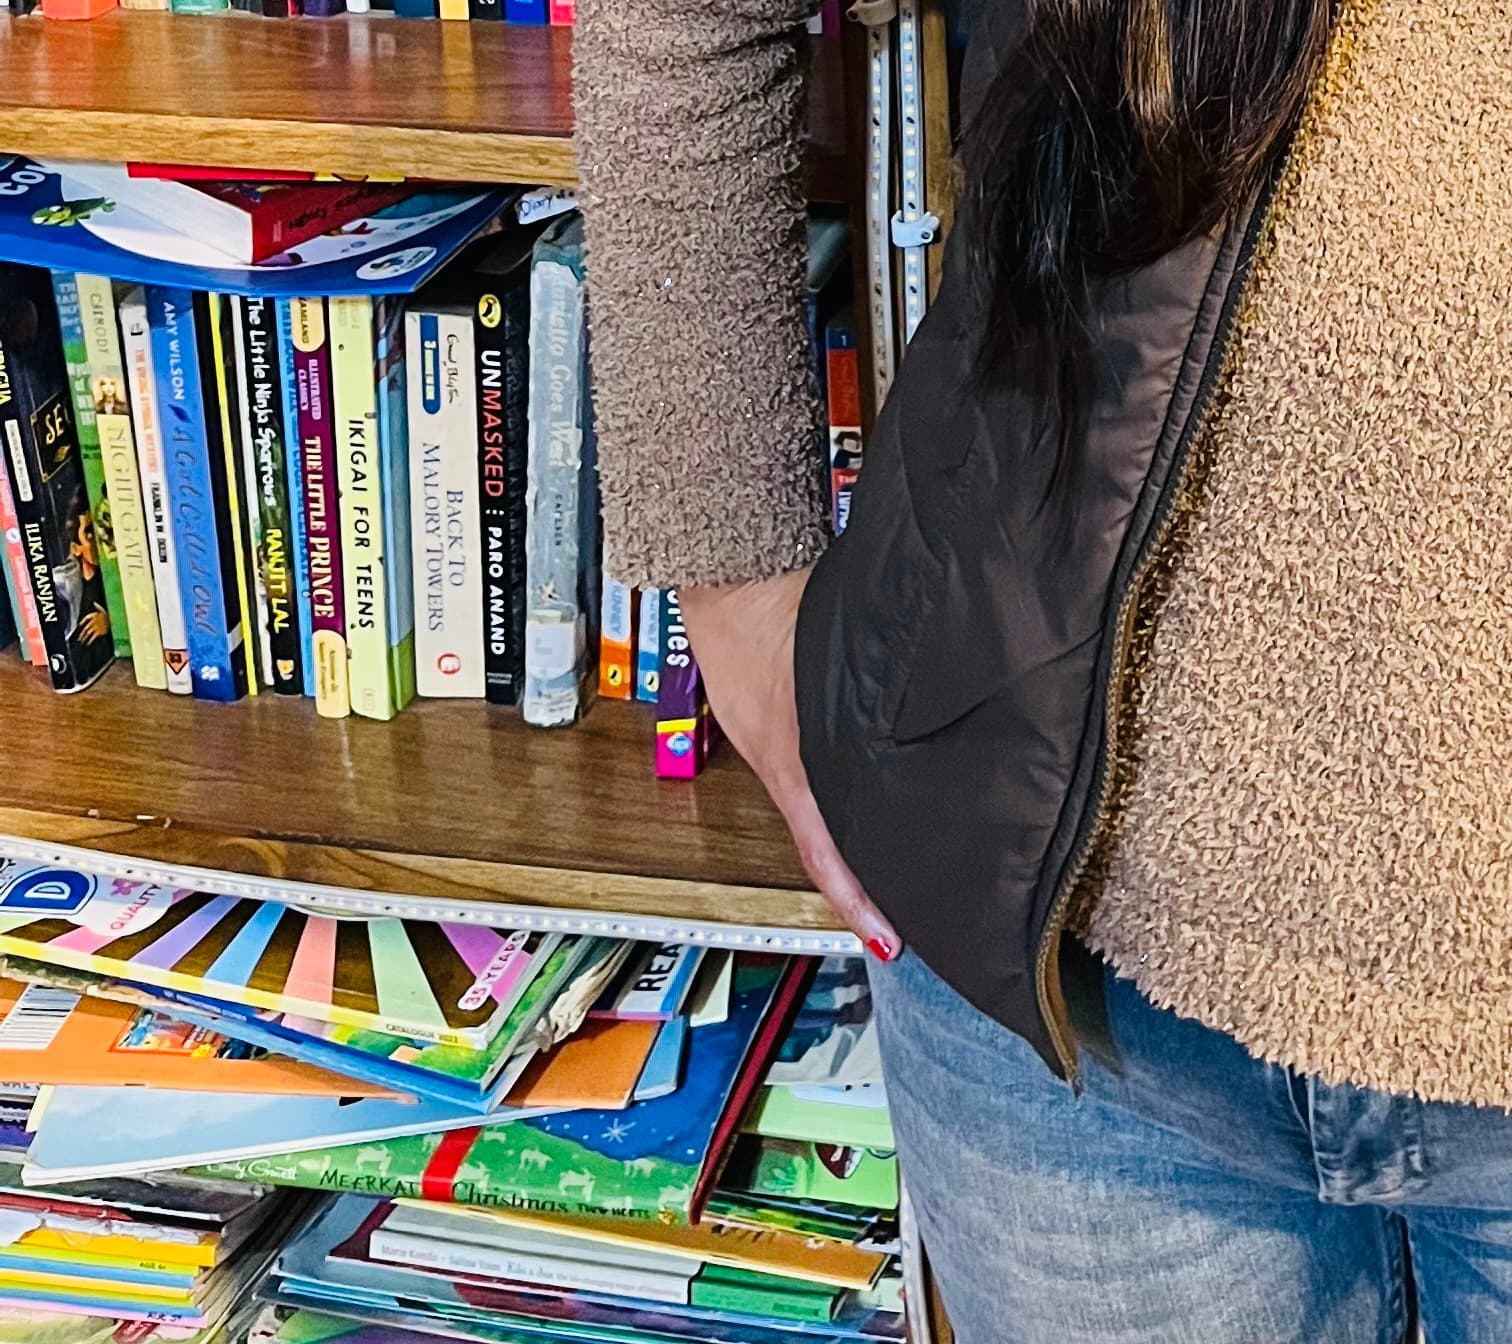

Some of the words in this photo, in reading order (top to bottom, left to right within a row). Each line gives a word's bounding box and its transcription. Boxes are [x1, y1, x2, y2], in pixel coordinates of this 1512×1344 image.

[348, 419, 368, 493] IKIGAI
[480, 349, 504, 498] UNMASKED
[423, 442, 441, 538] MALORY
[351, 506, 370, 548] FOR
[487, 525, 504, 578] PARO
[310, 540, 333, 619] PRINCE
[355, 564, 375, 630] TEENS
[426, 541, 445, 633] TOWERS
[488, 584, 506, 656] ANAND
[483, 932, 530, 982] YEARS
[319, 1168, 418, 1198] MEERKAT
[451, 1181, 569, 1215] Christmas
